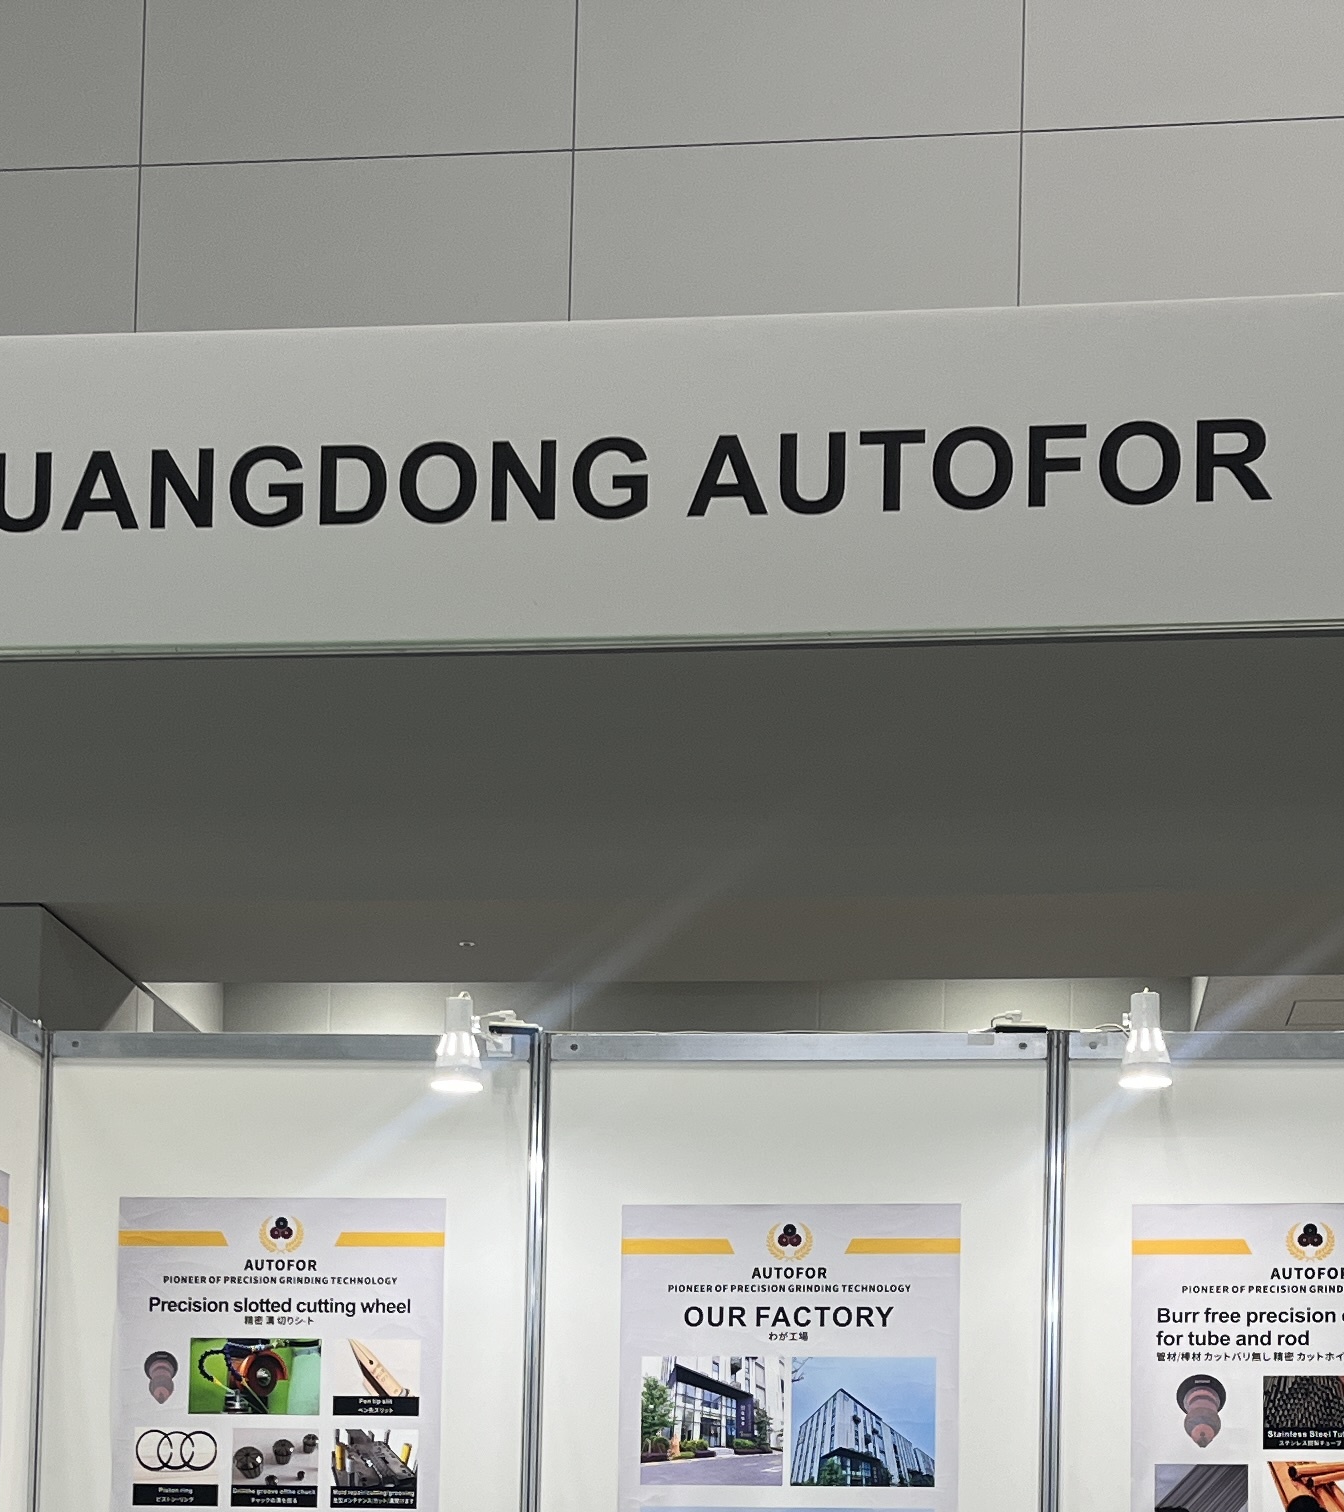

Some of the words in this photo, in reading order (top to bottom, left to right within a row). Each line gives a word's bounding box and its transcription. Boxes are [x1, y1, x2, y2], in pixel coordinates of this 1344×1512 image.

[686, 417, 1272, 519] AUTOFOR
[244, 1259, 318, 1272] AUTOFOR
[752, 1267, 827, 1279] AUTOFOR
[163, 1276, 207, 1285] PIONEER
[208, 1276, 222, 1285] OF
[223, 1276, 277, 1285] PRECISION
[279, 1276, 329, 1285] GRINDING
[331, 1276, 398, 1285] TECHNOLOGY
[668, 1284, 713, 1293] PIONEER
[715, 1284, 729, 1293] OF
[731, 1284, 786, 1293] PRECISION
[788, 1284, 839, 1293] GRINDING
[841, 1284, 911, 1293] TECHNOLOGY
[1182, 1284, 1229, 1294] PIONEER
[1231, 1284, 1246, 1294] OF
[1248, 1284, 1307, 1294] PRECISION
[149, 1296, 229, 1313] Precision
[233, 1297, 292, 1314] slotted
[296, 1298, 356, 1317] cutting
[360, 1298, 412, 1314] wheel
[684, 1306, 747, 1328] OUR
[755, 1306, 894, 1328] FACTORY
[1156, 1307, 1200, 1323] Burr
[1204, 1307, 1241, 1323] free
[1246, 1306, 1336, 1327] precision
[1156, 1330, 1185, 1346] for
[1187, 1330, 1231, 1346] tube
[1235, 1330, 1272, 1346] and
[1277, 1330, 1310, 1346] rod
[1267, 1430, 1307, 1438] Stainless
[1309, 1430, 1332, 1438] Steel
